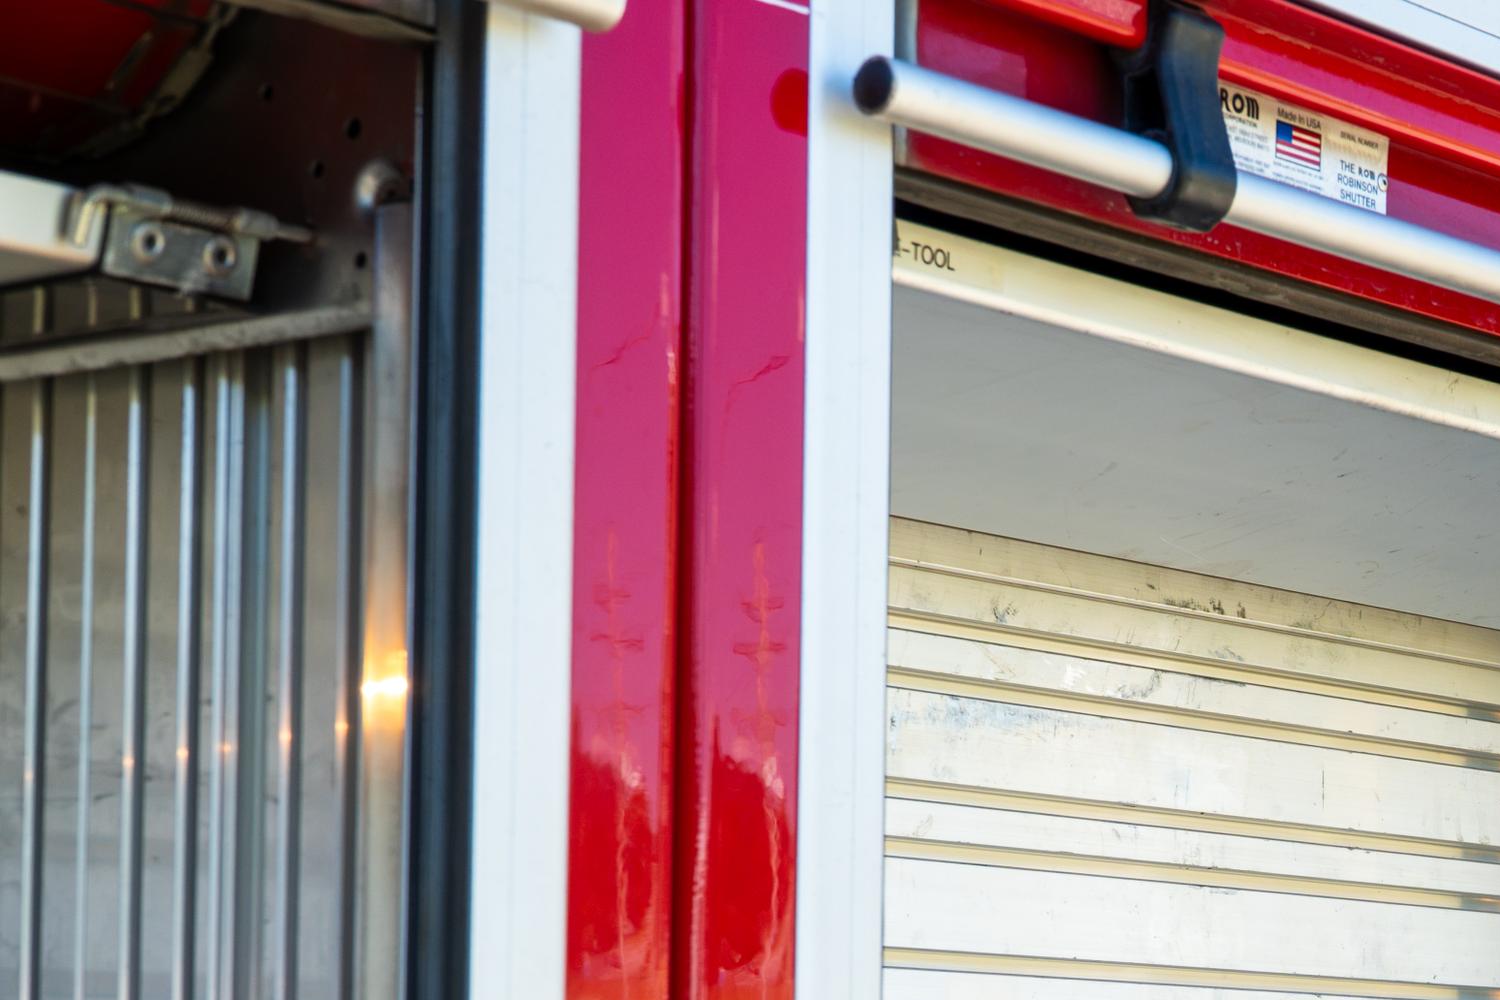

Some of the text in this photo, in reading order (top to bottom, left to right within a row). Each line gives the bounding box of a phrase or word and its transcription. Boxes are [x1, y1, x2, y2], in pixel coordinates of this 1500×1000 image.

[1277, 107, 1297, 122] Made
[1306, 116, 1322, 131] USA
[1340, 130, 1379, 150] SERIAL NUMBER
[1340, 159, 1356, 175] THE
[1337, 173, 1379, 195] ROBINSON
[1340, 188, 1377, 209] SHUTTER
